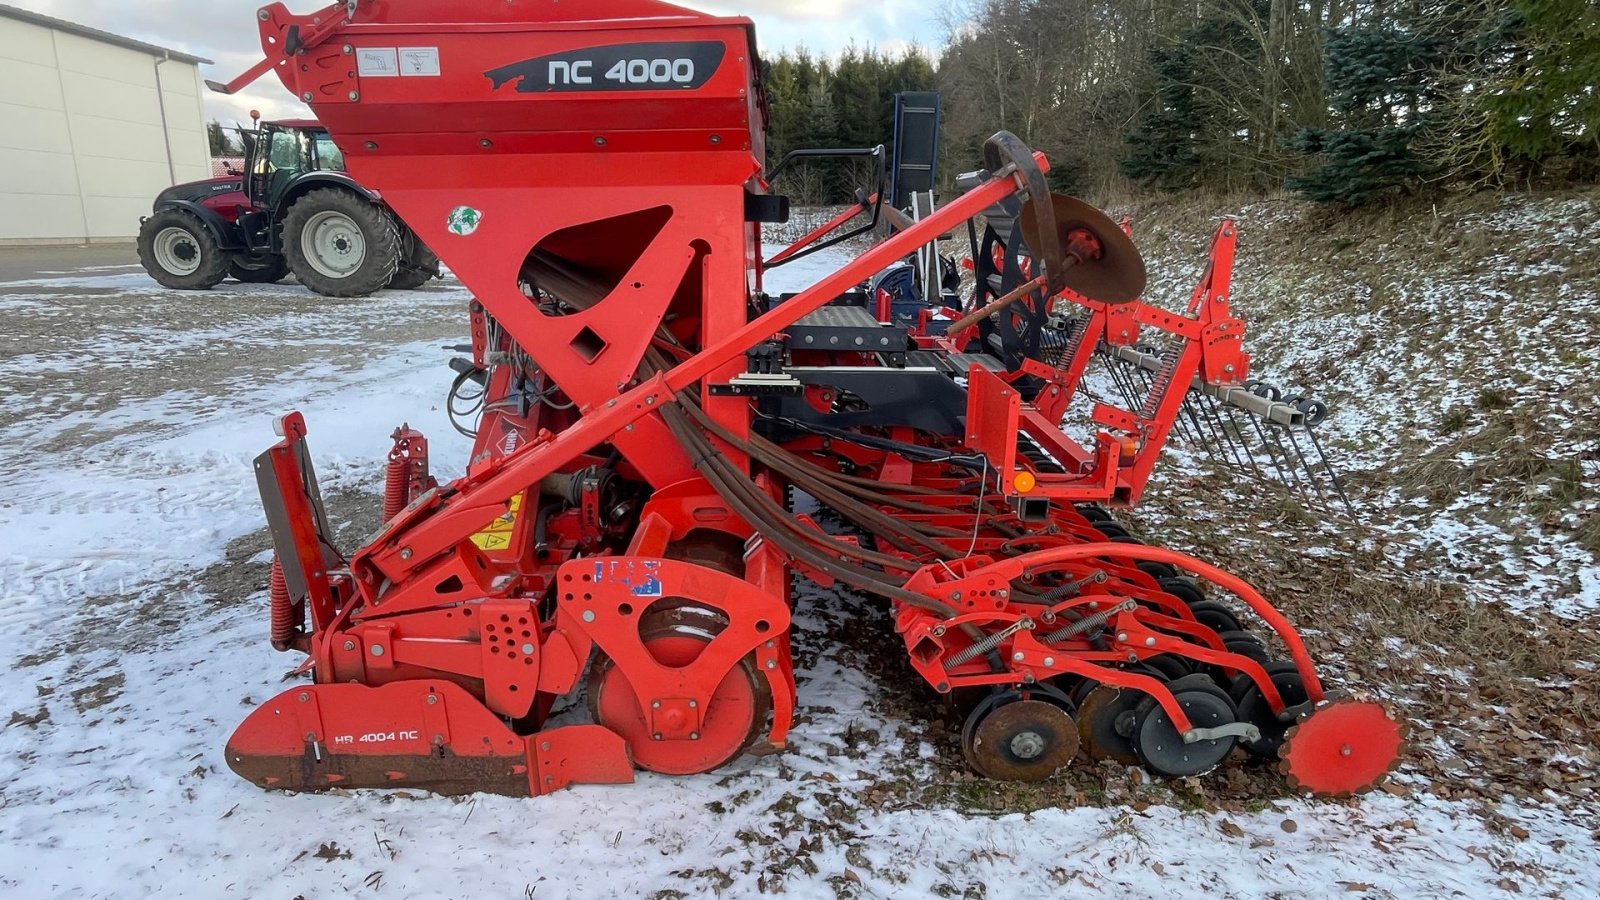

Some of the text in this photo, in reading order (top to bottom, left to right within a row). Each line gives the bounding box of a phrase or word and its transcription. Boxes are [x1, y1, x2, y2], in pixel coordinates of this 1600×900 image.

[604, 58, 695, 84] 4000
[334, 735, 354, 744] HR
[359, 732, 396, 743] 4004
